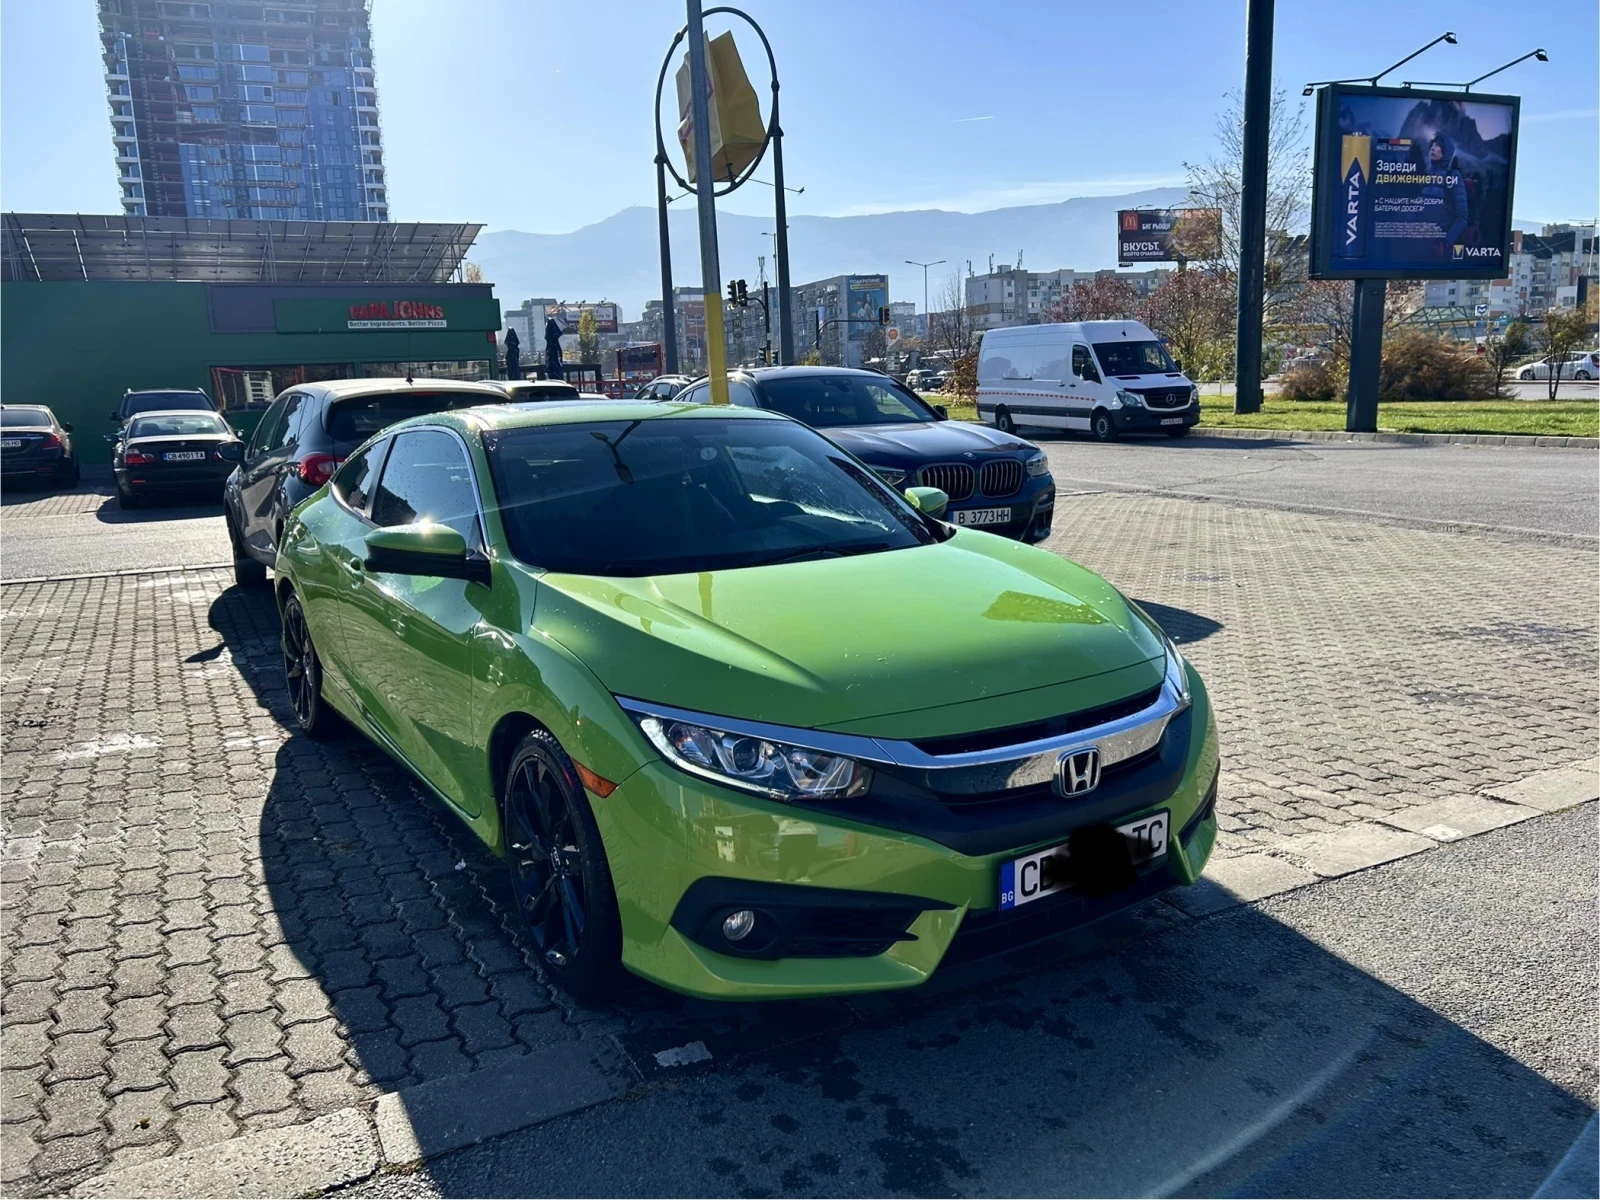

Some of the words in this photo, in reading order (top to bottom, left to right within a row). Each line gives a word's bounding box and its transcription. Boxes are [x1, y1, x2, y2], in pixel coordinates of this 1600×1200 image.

[1376, 160, 1416, 173] Зареди
[1375, 174, 1443, 184] движението
[1446, 175, 1458, 184] си
[1410, 196, 1444, 205] НАЙ-ДОБРИ
[1346, 171, 1360, 246] VARTA
[1123, 242, 1160, 251] ВКУСЪТ,
[1466, 248, 1501, 256] VARTA
[350, 302, 390, 319] PAPA
[958, 512, 965, 524] B
[970, 510, 994, 524] 3773
[996, 509, 1010, 521] HH
[1132, 819, 1162, 858] TC
[1002, 890, 1014, 904] BG
